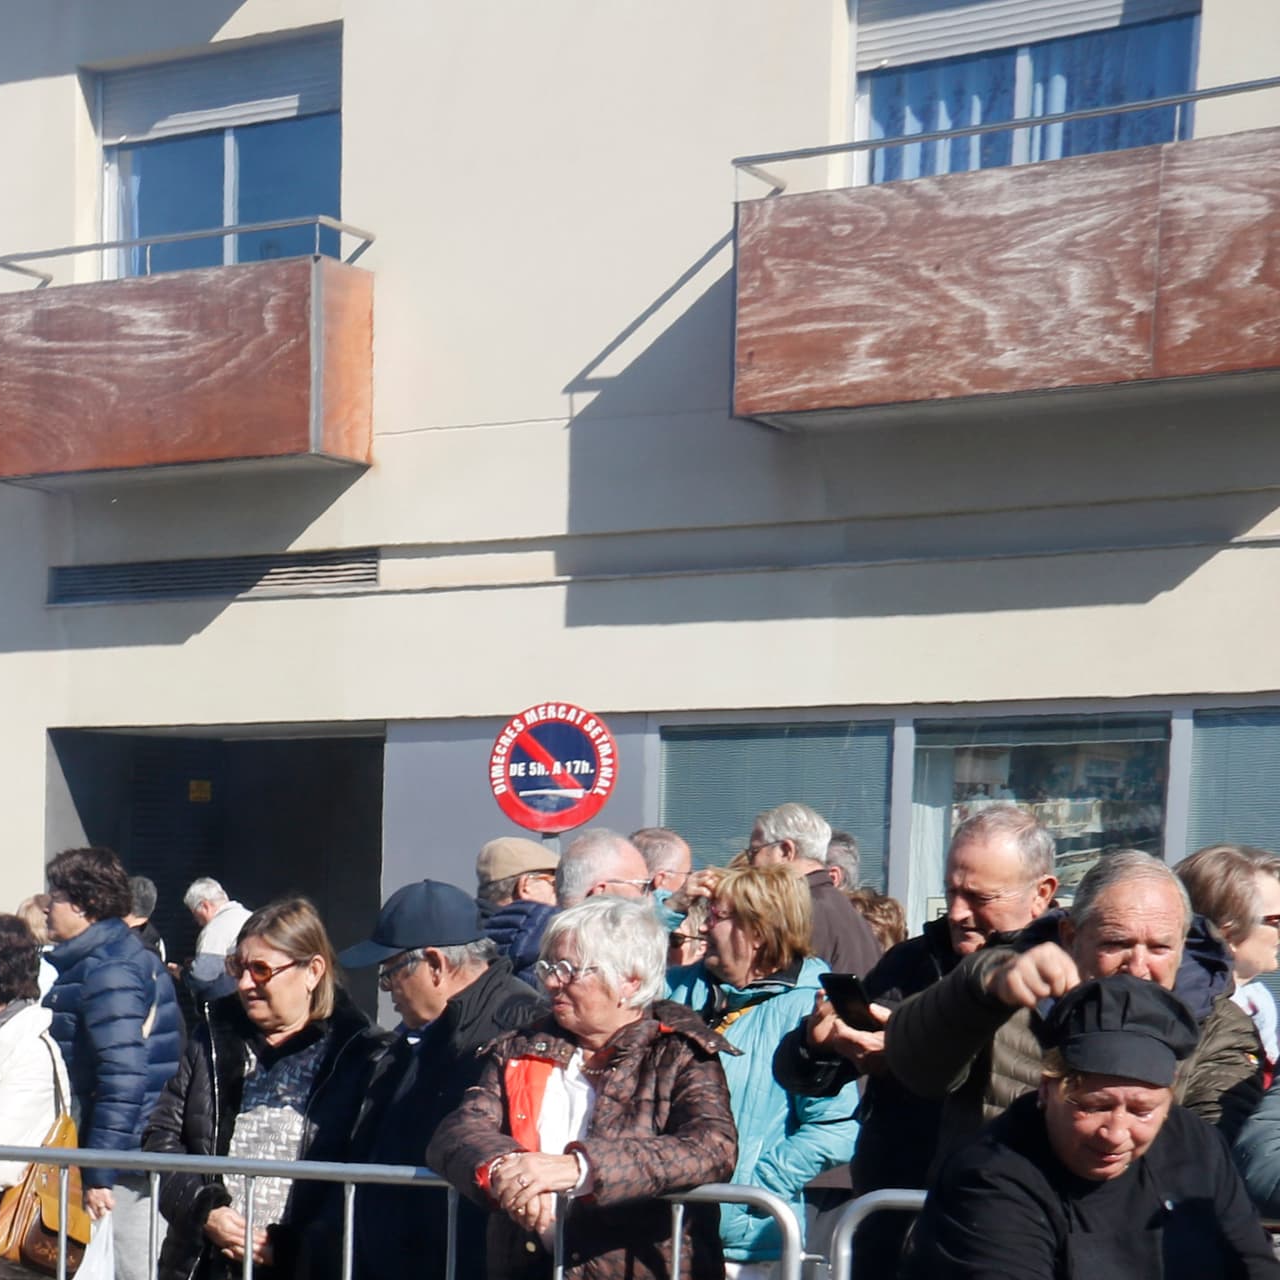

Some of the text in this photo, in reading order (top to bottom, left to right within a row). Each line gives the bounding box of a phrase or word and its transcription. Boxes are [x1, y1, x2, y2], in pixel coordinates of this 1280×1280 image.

[490, 704, 614, 796] DIMECRES MERCAT SETMANAL
[509, 760, 595, 777] DE 5h. A 17h.
